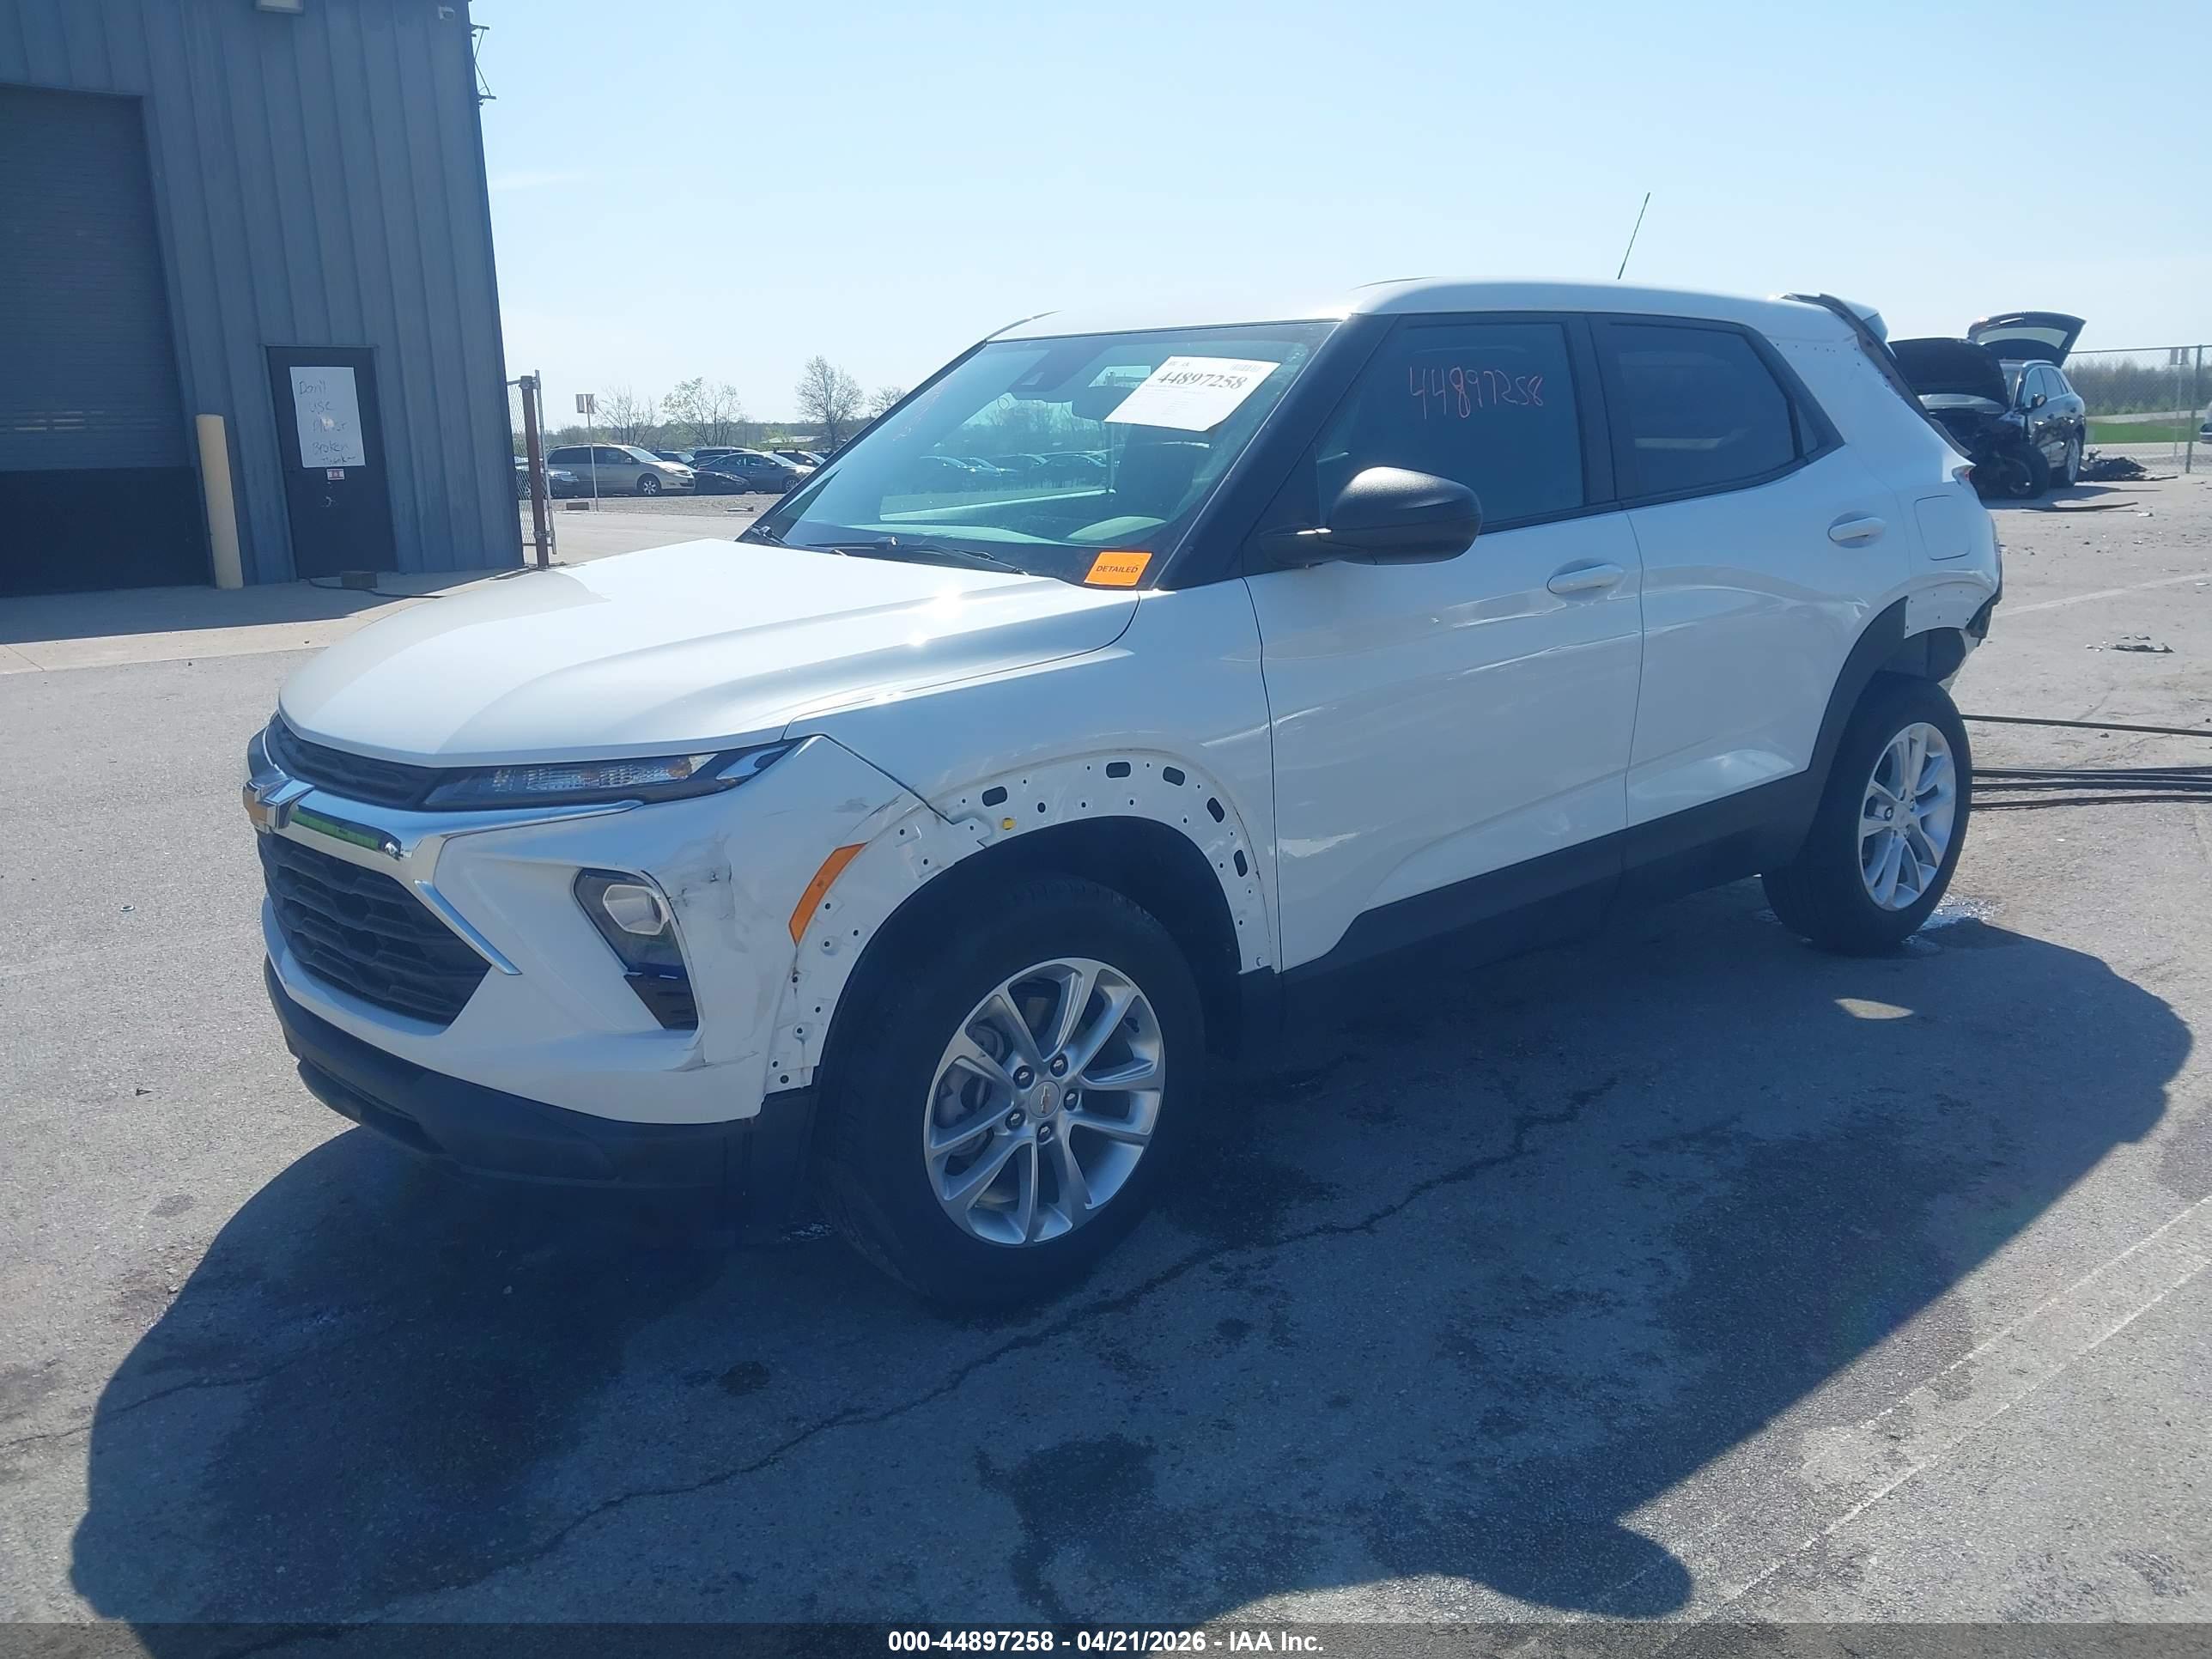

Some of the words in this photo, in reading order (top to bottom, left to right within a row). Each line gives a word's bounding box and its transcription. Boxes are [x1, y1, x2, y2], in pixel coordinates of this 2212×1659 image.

[1157, 371, 1249, 391] 44897258
[1409, 366, 1544, 420] 44897258
[1096, 565, 1139, 574] DETAILED
